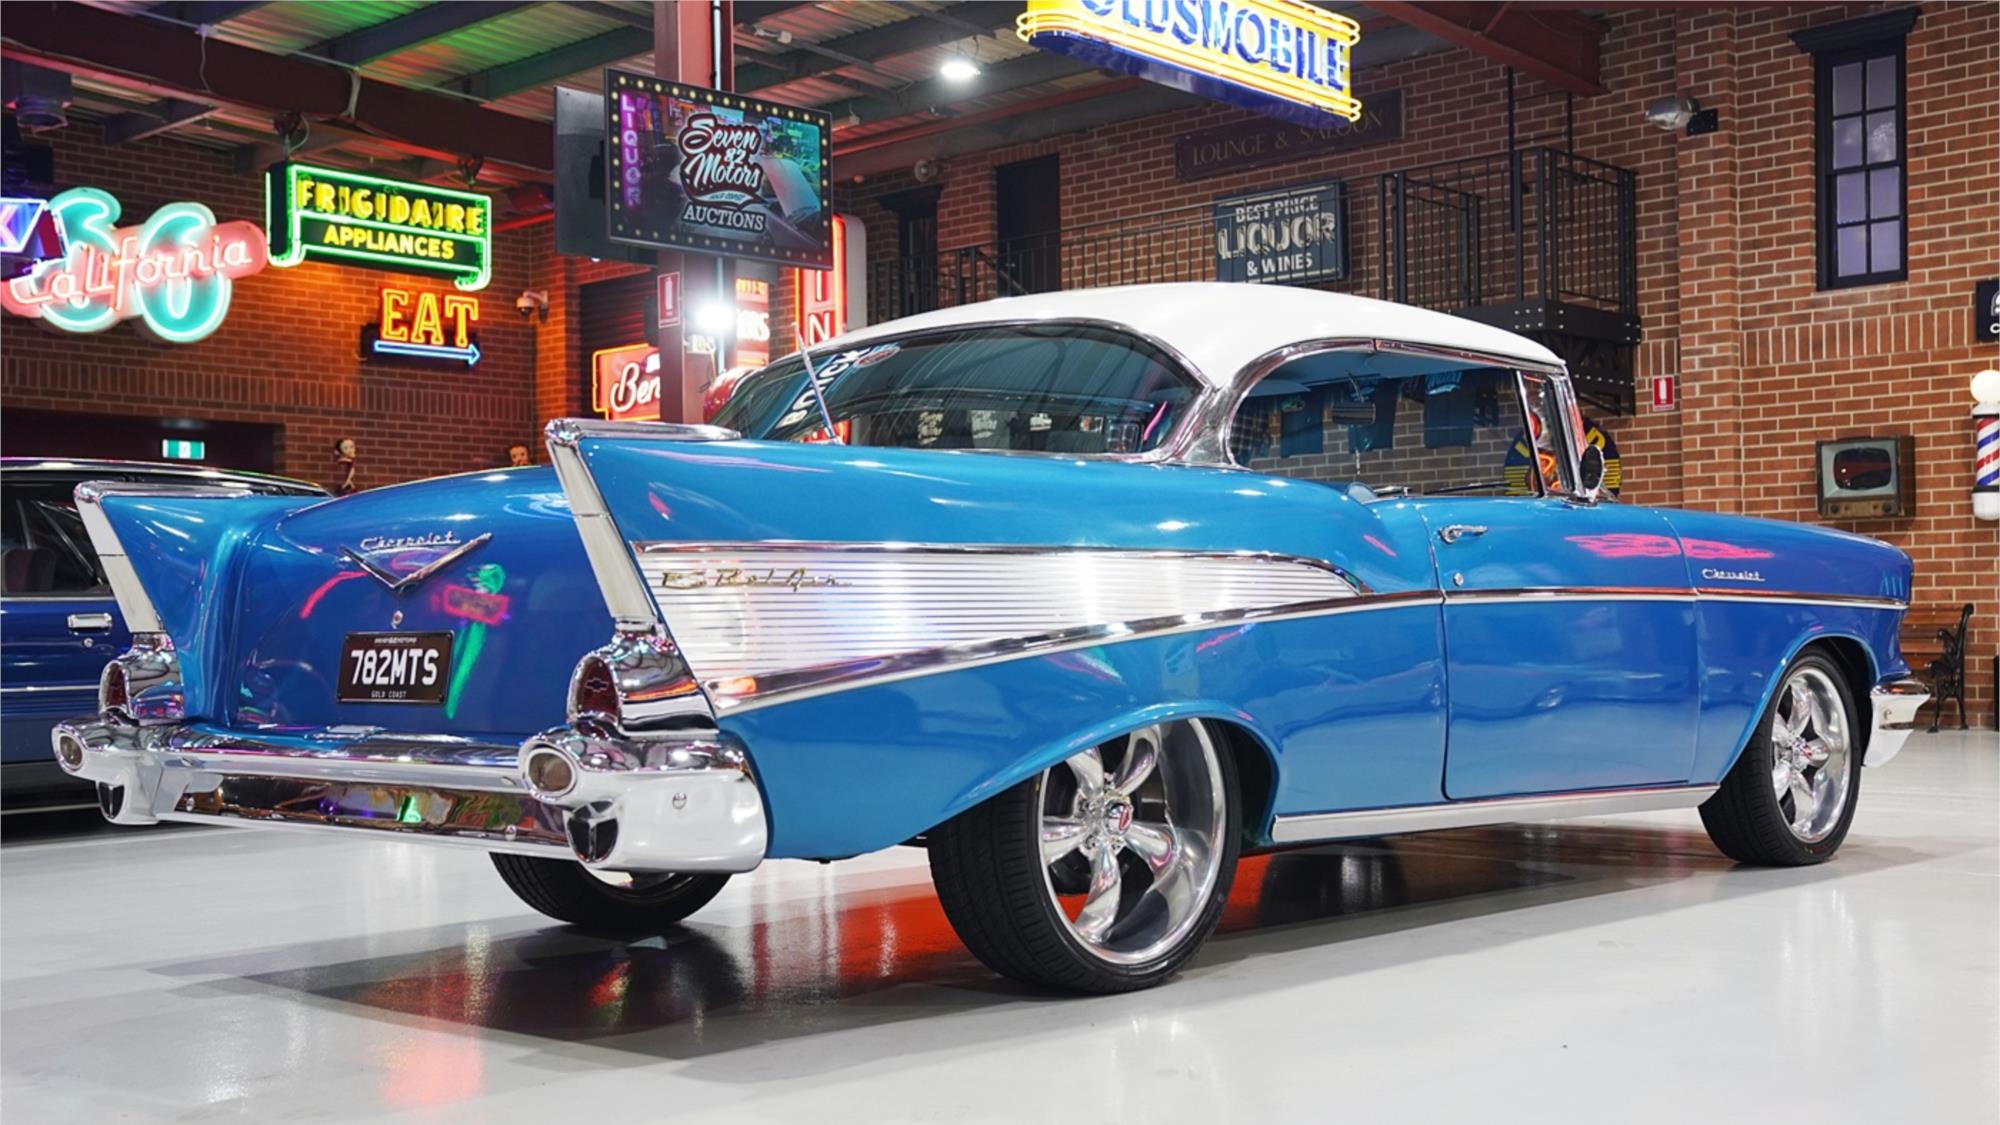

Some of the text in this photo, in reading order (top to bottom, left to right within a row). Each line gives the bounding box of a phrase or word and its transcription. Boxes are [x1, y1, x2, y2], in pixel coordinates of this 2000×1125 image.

[621, 94, 641, 206] LIQUOR
[683, 118, 758, 154] Seven
[1193, 133, 1266, 166] LOUNGE
[1275, 130, 1289, 149] &
[685, 152, 761, 189] Motors
[724, 147, 747, 165] 82
[297, 179, 485, 236] FRIGIDAIRE
[683, 204, 765, 231] AUCTIONS
[1235, 195, 1319, 223] BEST PRICE
[323, 224, 455, 259] APPLIANCES
[1217, 211, 1336, 260] LIQUOR
[9, 235, 254, 312] California
[1246, 252, 1313, 276] & WINES
[380, 288, 479, 348] EAT
[360, 530, 462, 551] Chevrolet
[351, 648, 439, 685] 782MTS
